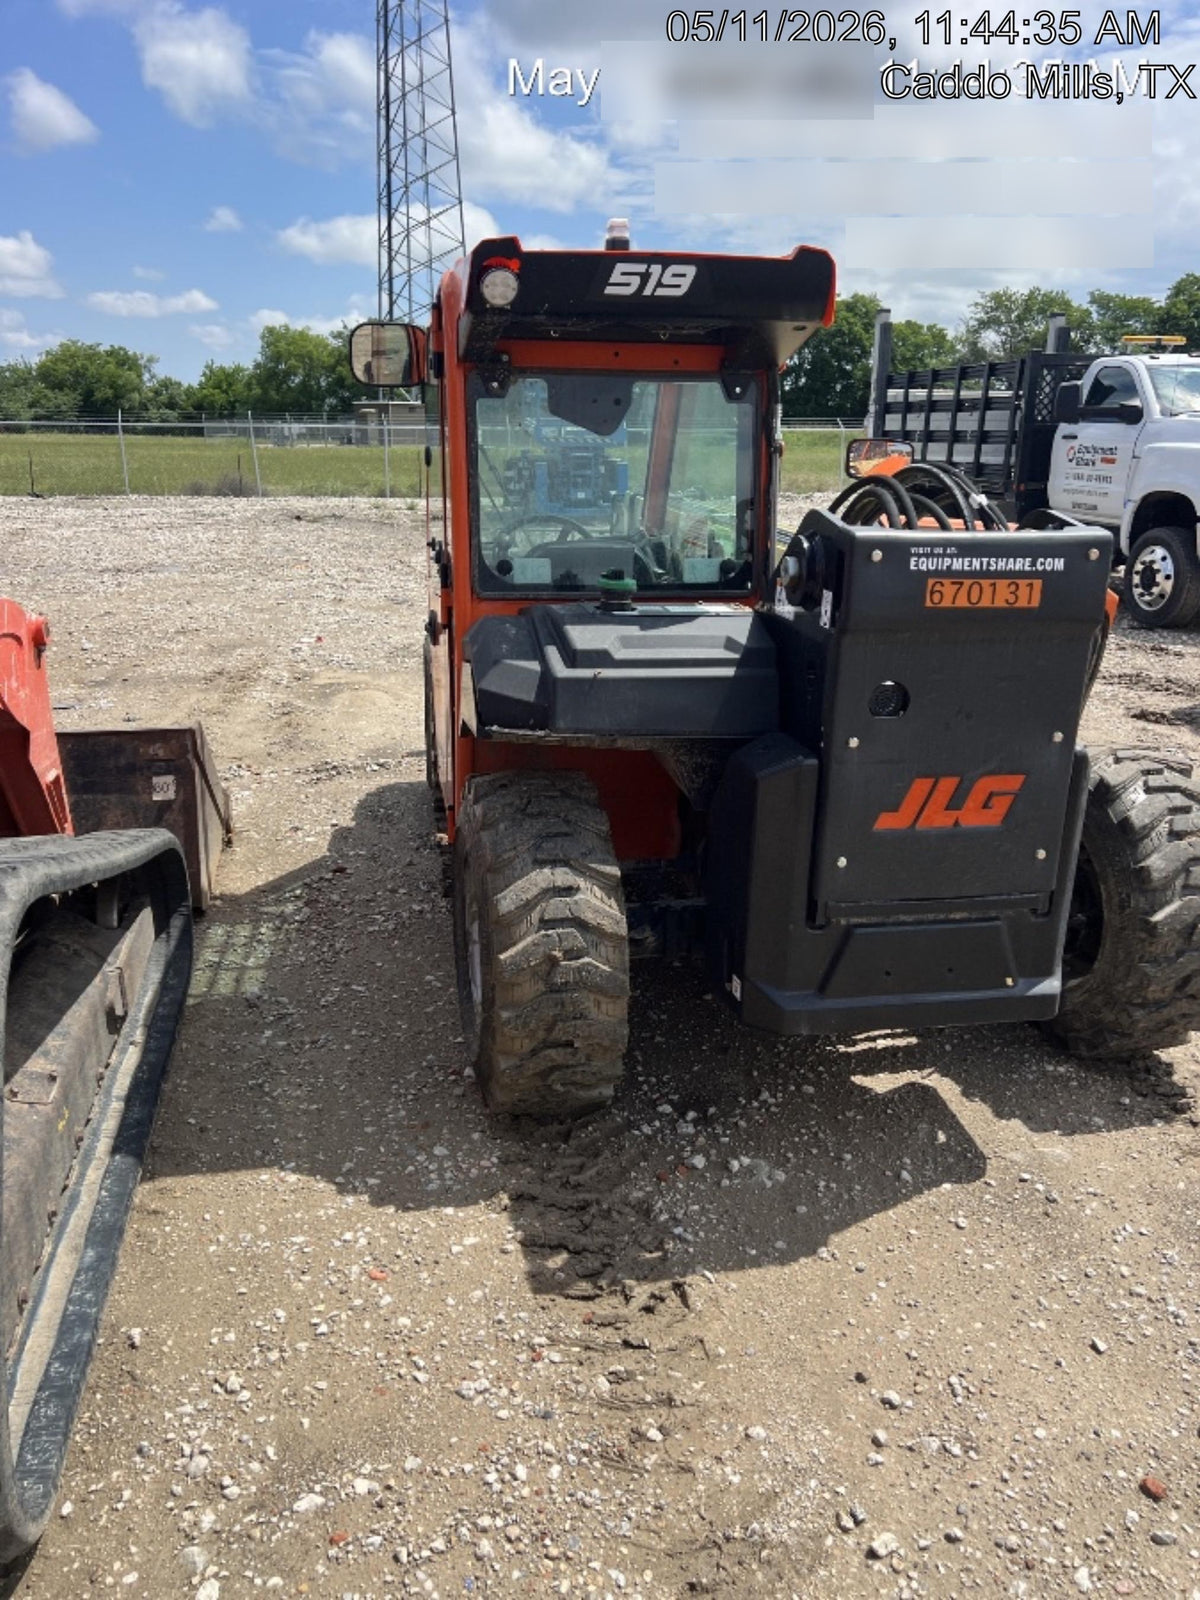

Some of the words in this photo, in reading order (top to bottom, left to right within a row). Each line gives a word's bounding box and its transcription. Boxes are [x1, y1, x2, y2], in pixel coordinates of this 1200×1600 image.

[603, 262, 698, 297] 519
[909, 546, 931, 555] VISIT
[909, 556, 1065, 572] EQUIPMENTSHARE.COM
[929, 580, 1035, 606] 670131
[872, 773, 1027, 831] JLG
